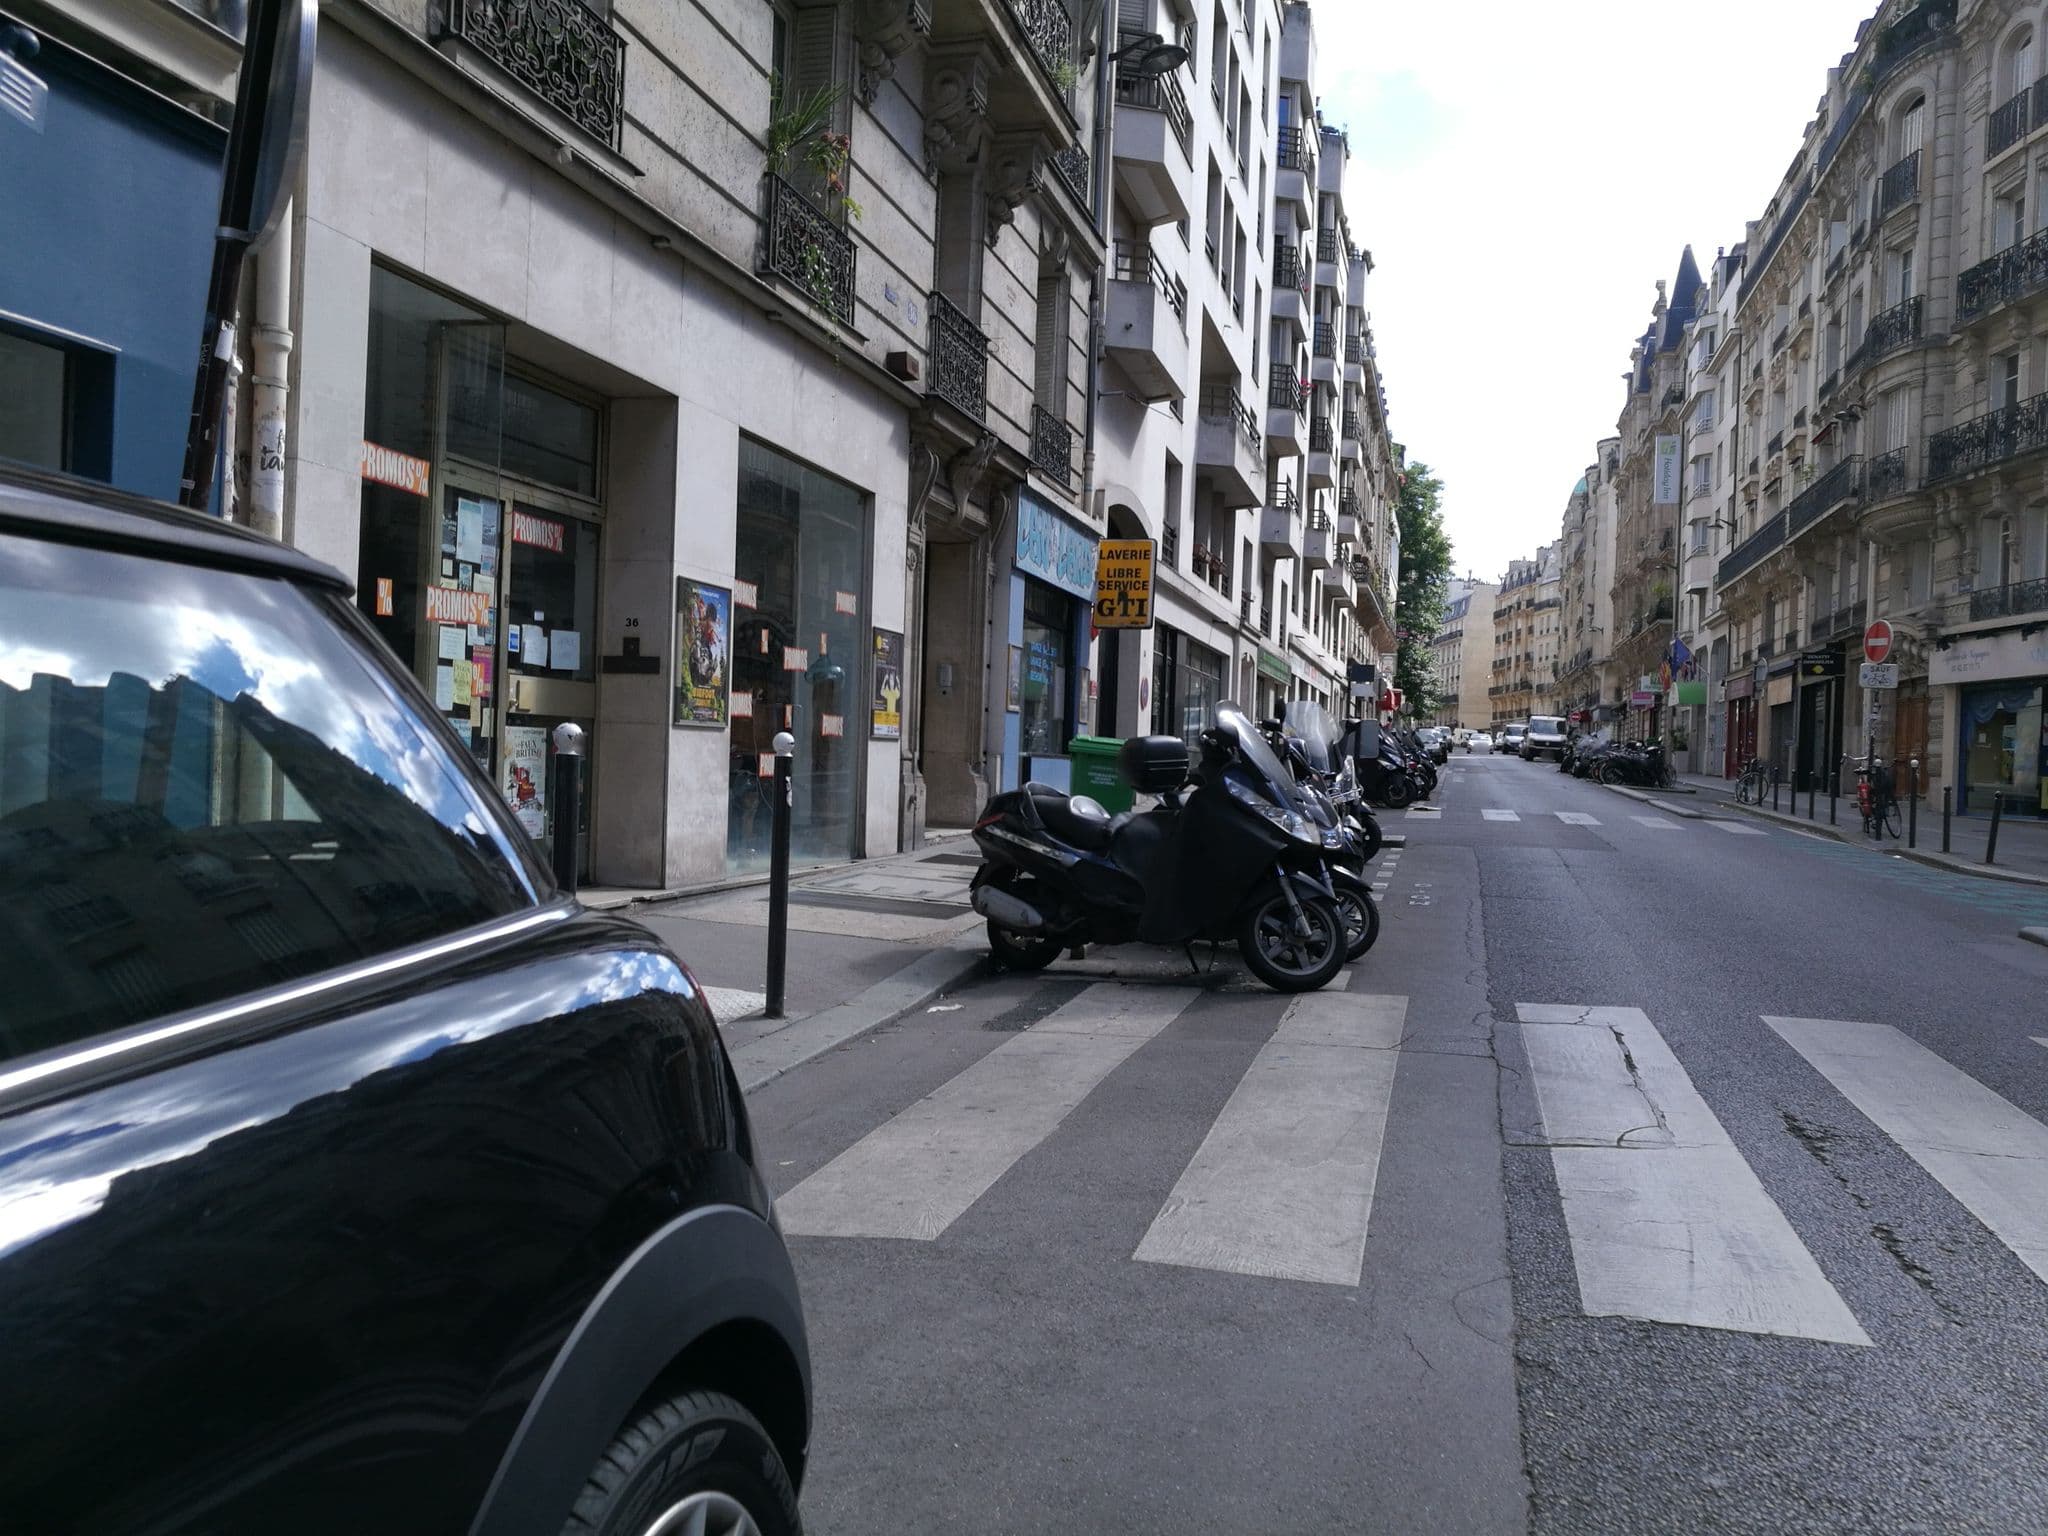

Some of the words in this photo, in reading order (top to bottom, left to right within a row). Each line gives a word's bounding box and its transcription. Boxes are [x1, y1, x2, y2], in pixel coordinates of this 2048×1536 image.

[1662, 458, 1672, 486] Holiday
[1663, 487, 1672, 499] Inn
[1099, 549, 1151, 561] LAVERIE
[1107, 567, 1142, 579] LIBRE
[1098, 580, 1150, 591] SERVICE
[1097, 597, 1149, 617] GTI
[625, 617, 639, 628] 36
